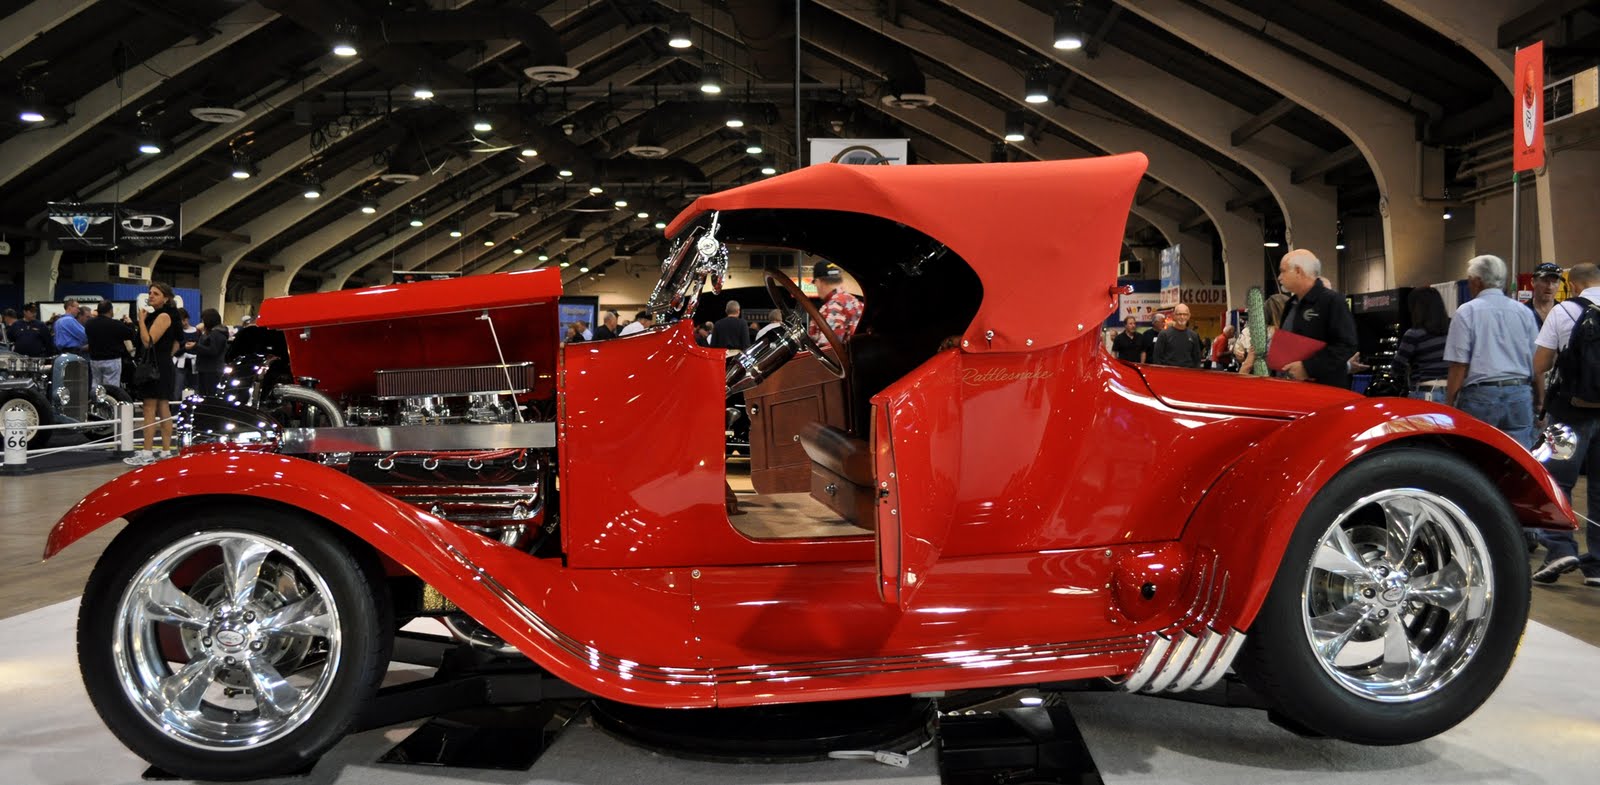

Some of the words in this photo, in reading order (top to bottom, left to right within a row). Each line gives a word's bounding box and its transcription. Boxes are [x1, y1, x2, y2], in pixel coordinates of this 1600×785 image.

[1195, 288, 1220, 304] COLD
[1126, 306, 1141, 314] HOT
[961, 366, 1054, 386] Rattlesnake
[8, 436, 26, 448] 66
